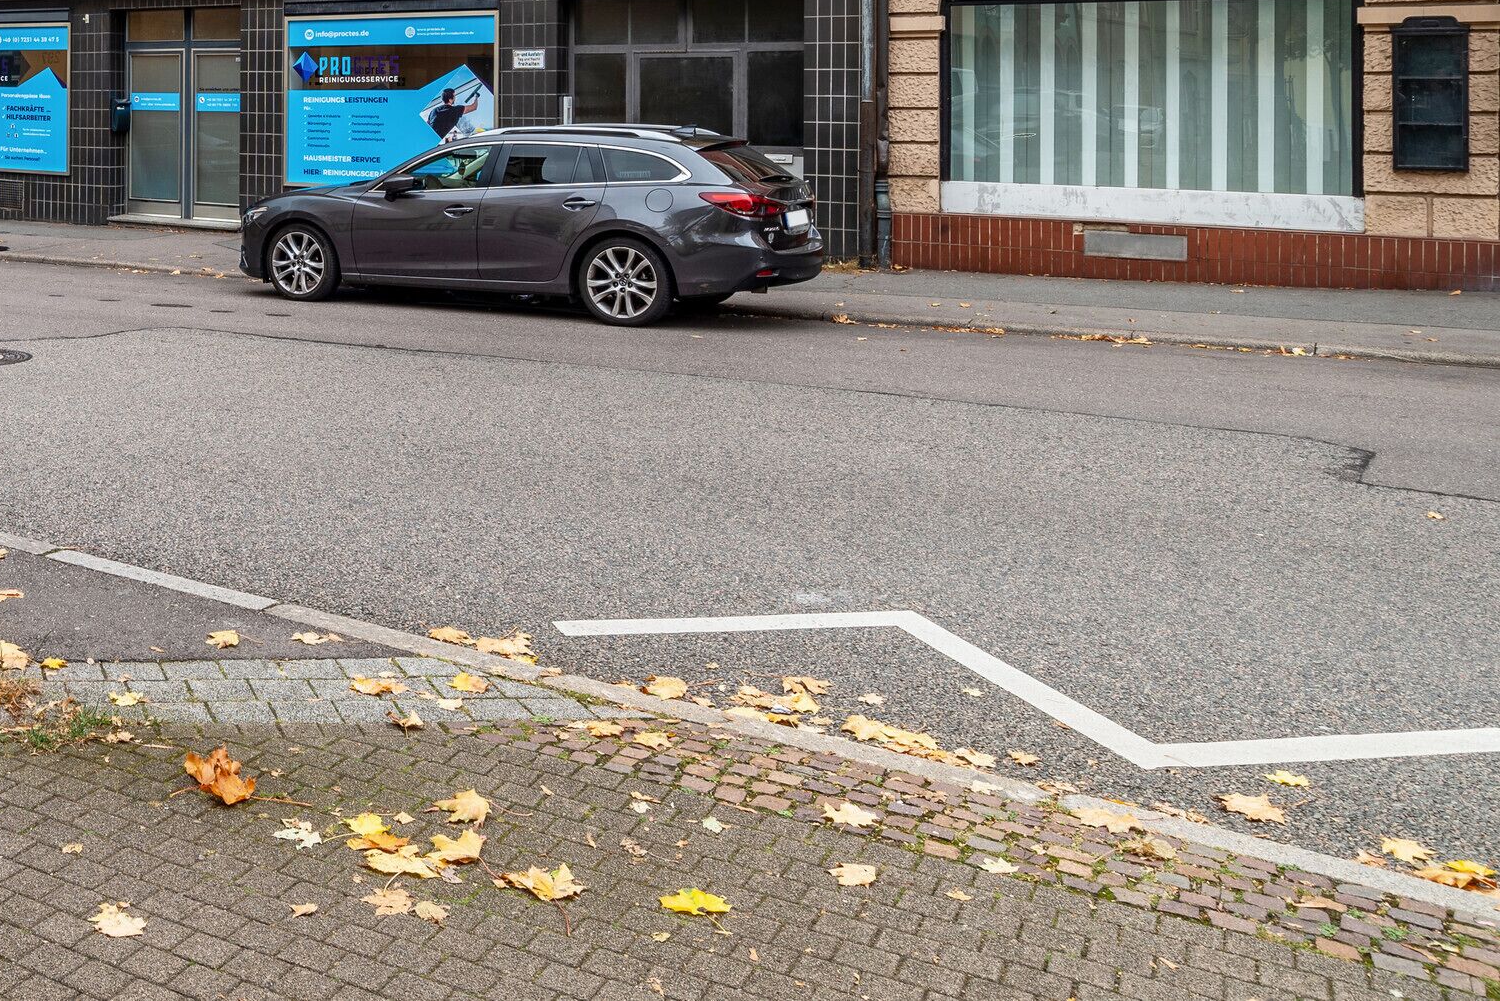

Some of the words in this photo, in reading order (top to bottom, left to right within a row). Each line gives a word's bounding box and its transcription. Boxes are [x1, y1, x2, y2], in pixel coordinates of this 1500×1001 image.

[315, 30, 370, 39] info@proctes.de
[319, 56, 399, 76] PROCTES
[319, 75, 399, 83] REINIGUNGSSERVICE
[6, 104, 45, 113] FACHKRÄFTE
[6, 114, 51, 122] HILFSARBEITER
[304, 155, 381, 163] HAUSMEISTERSERVICE
